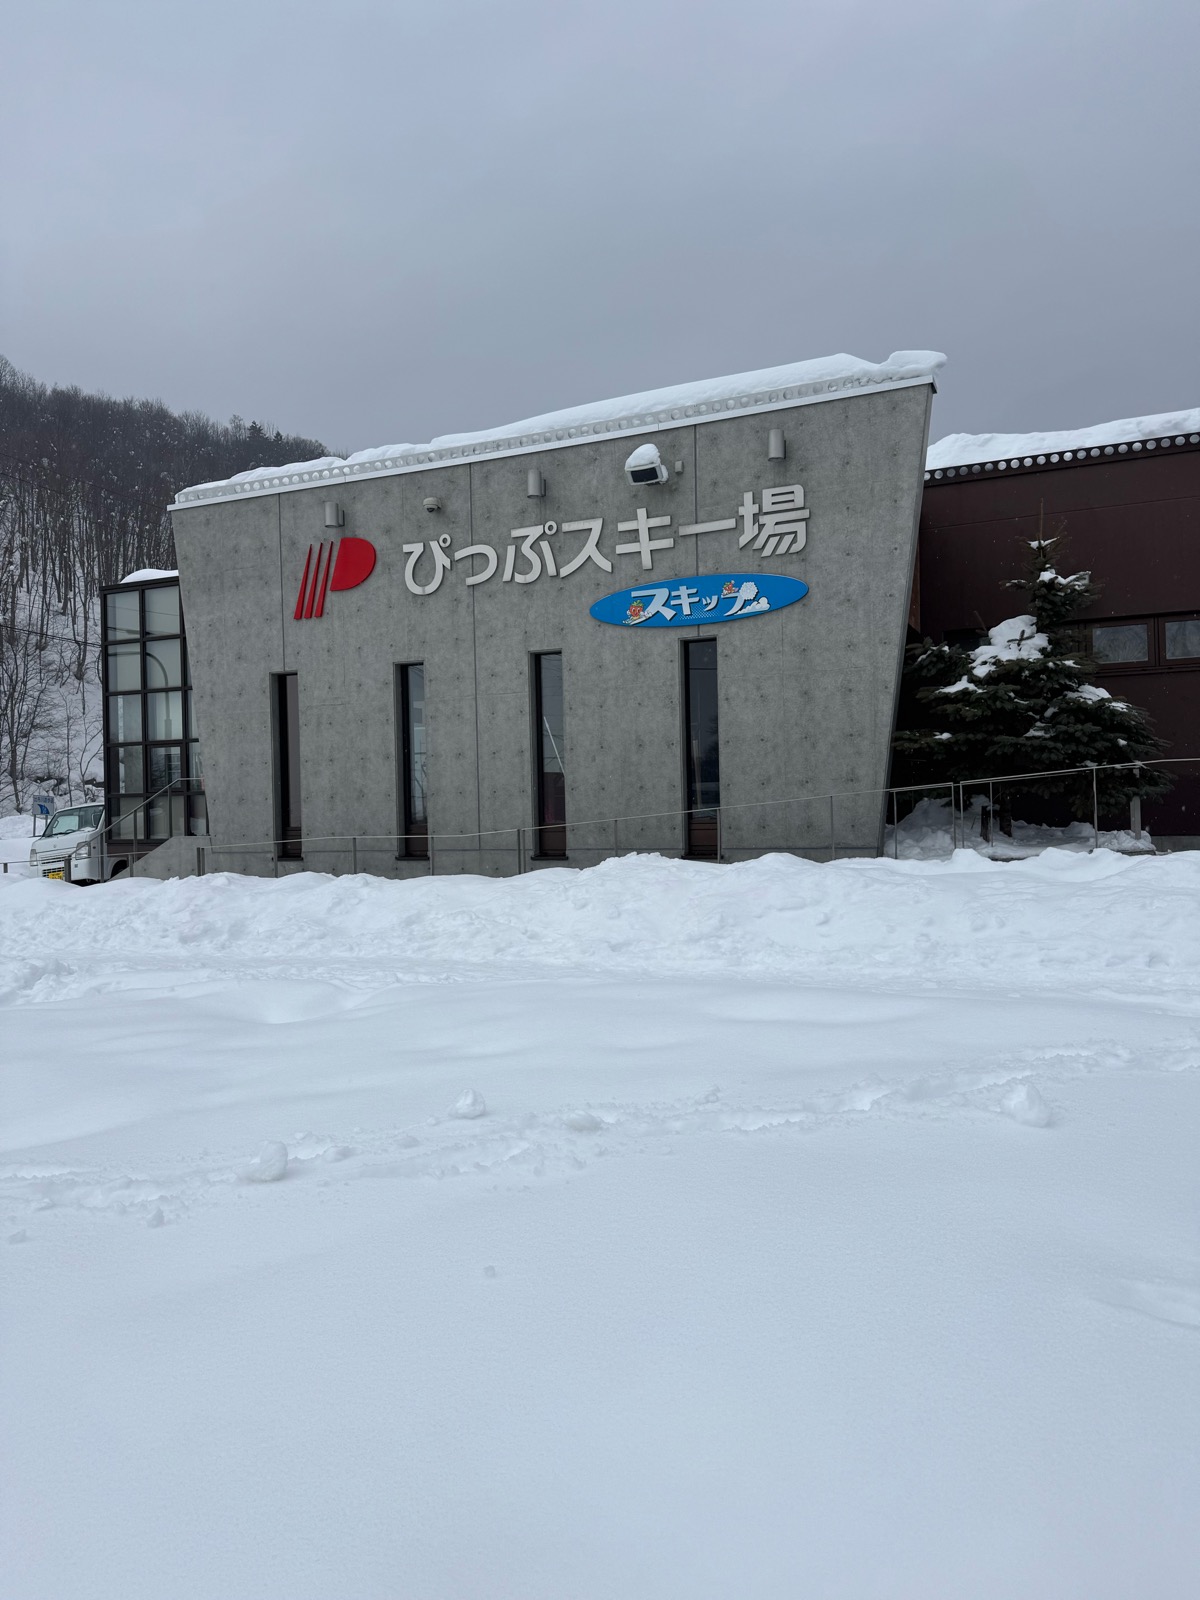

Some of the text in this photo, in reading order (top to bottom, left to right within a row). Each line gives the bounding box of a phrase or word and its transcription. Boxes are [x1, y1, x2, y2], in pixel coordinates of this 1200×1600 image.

[402, 484, 811, 596] ぴっぷスキー場
[630, 581, 759, 622] スキップ
